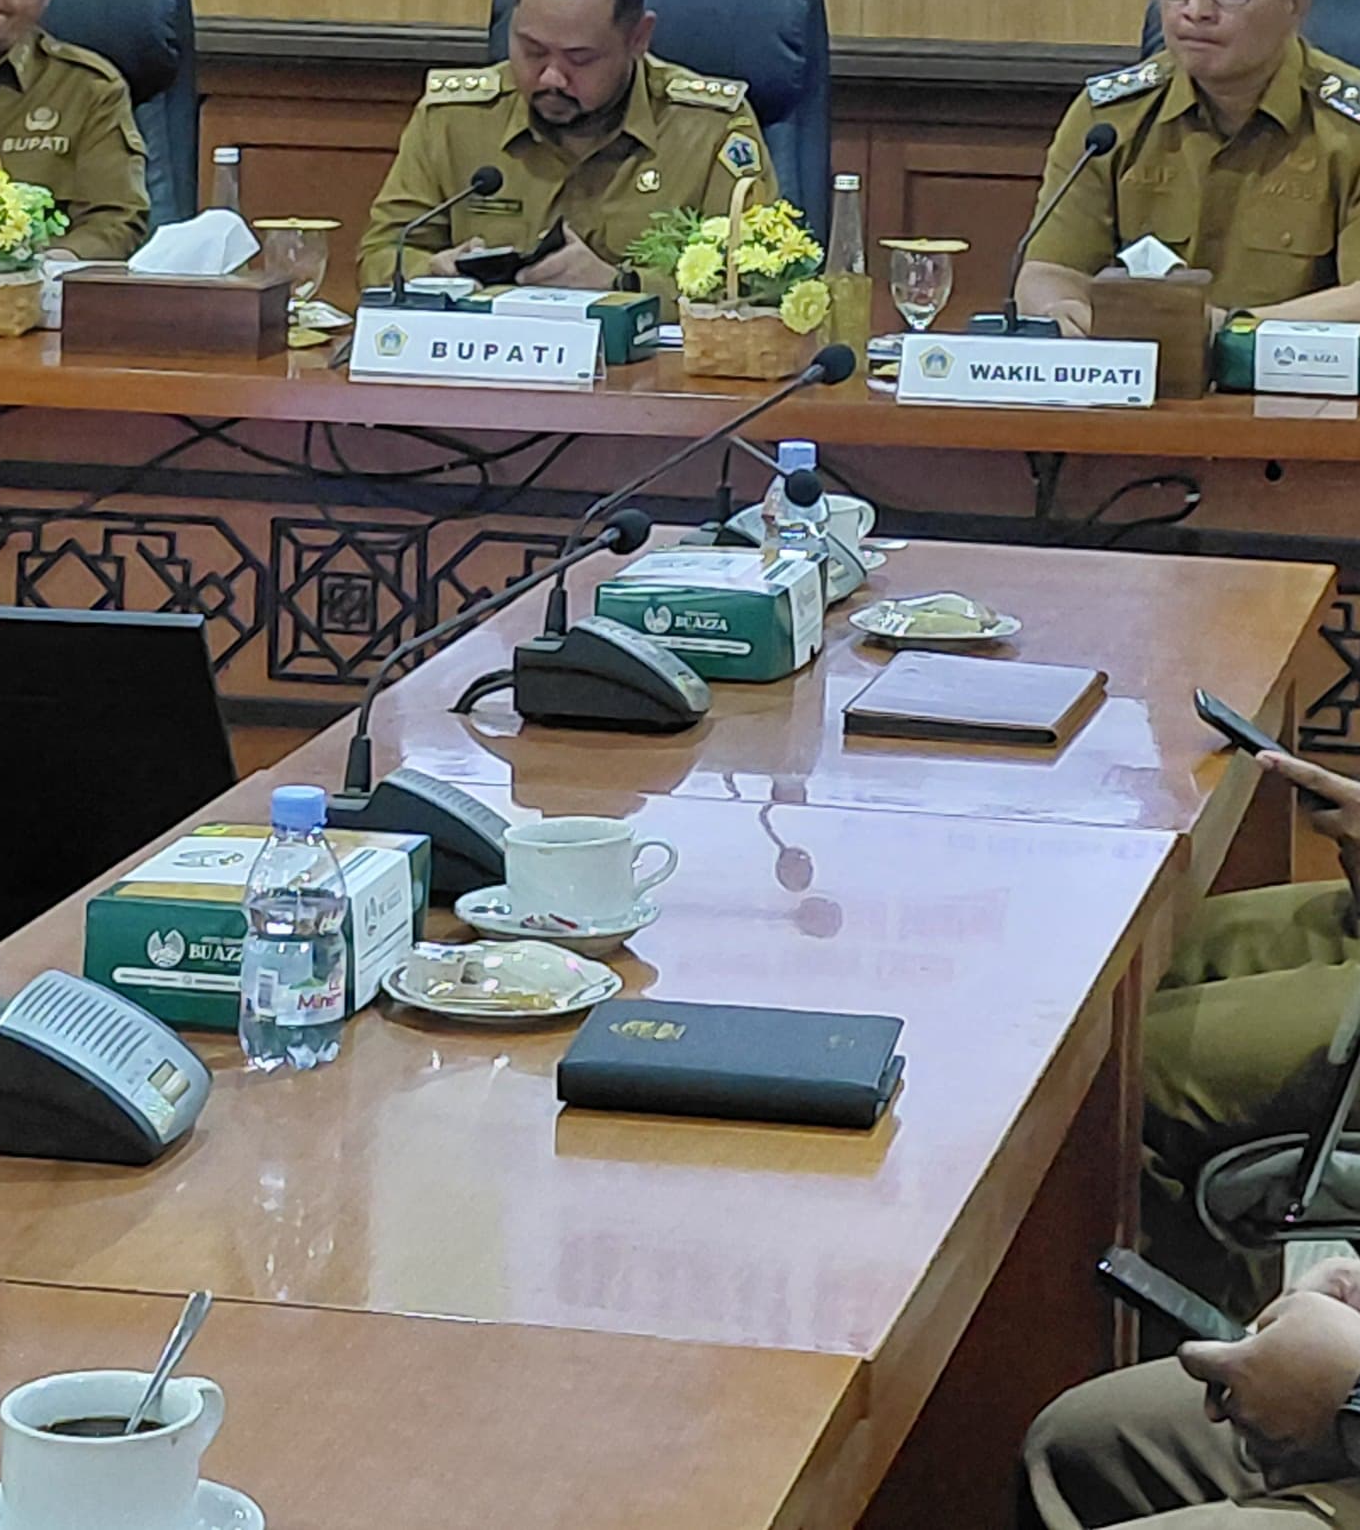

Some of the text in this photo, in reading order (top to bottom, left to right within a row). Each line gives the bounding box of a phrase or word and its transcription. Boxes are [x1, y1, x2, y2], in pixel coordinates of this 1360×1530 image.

[2, 136, 70, 154] BUPATI
[431, 341, 566, 365] BUPATI
[969, 364, 1141, 385] WAKIL BUPATI
[189, 942, 243, 962] BUAZZ
